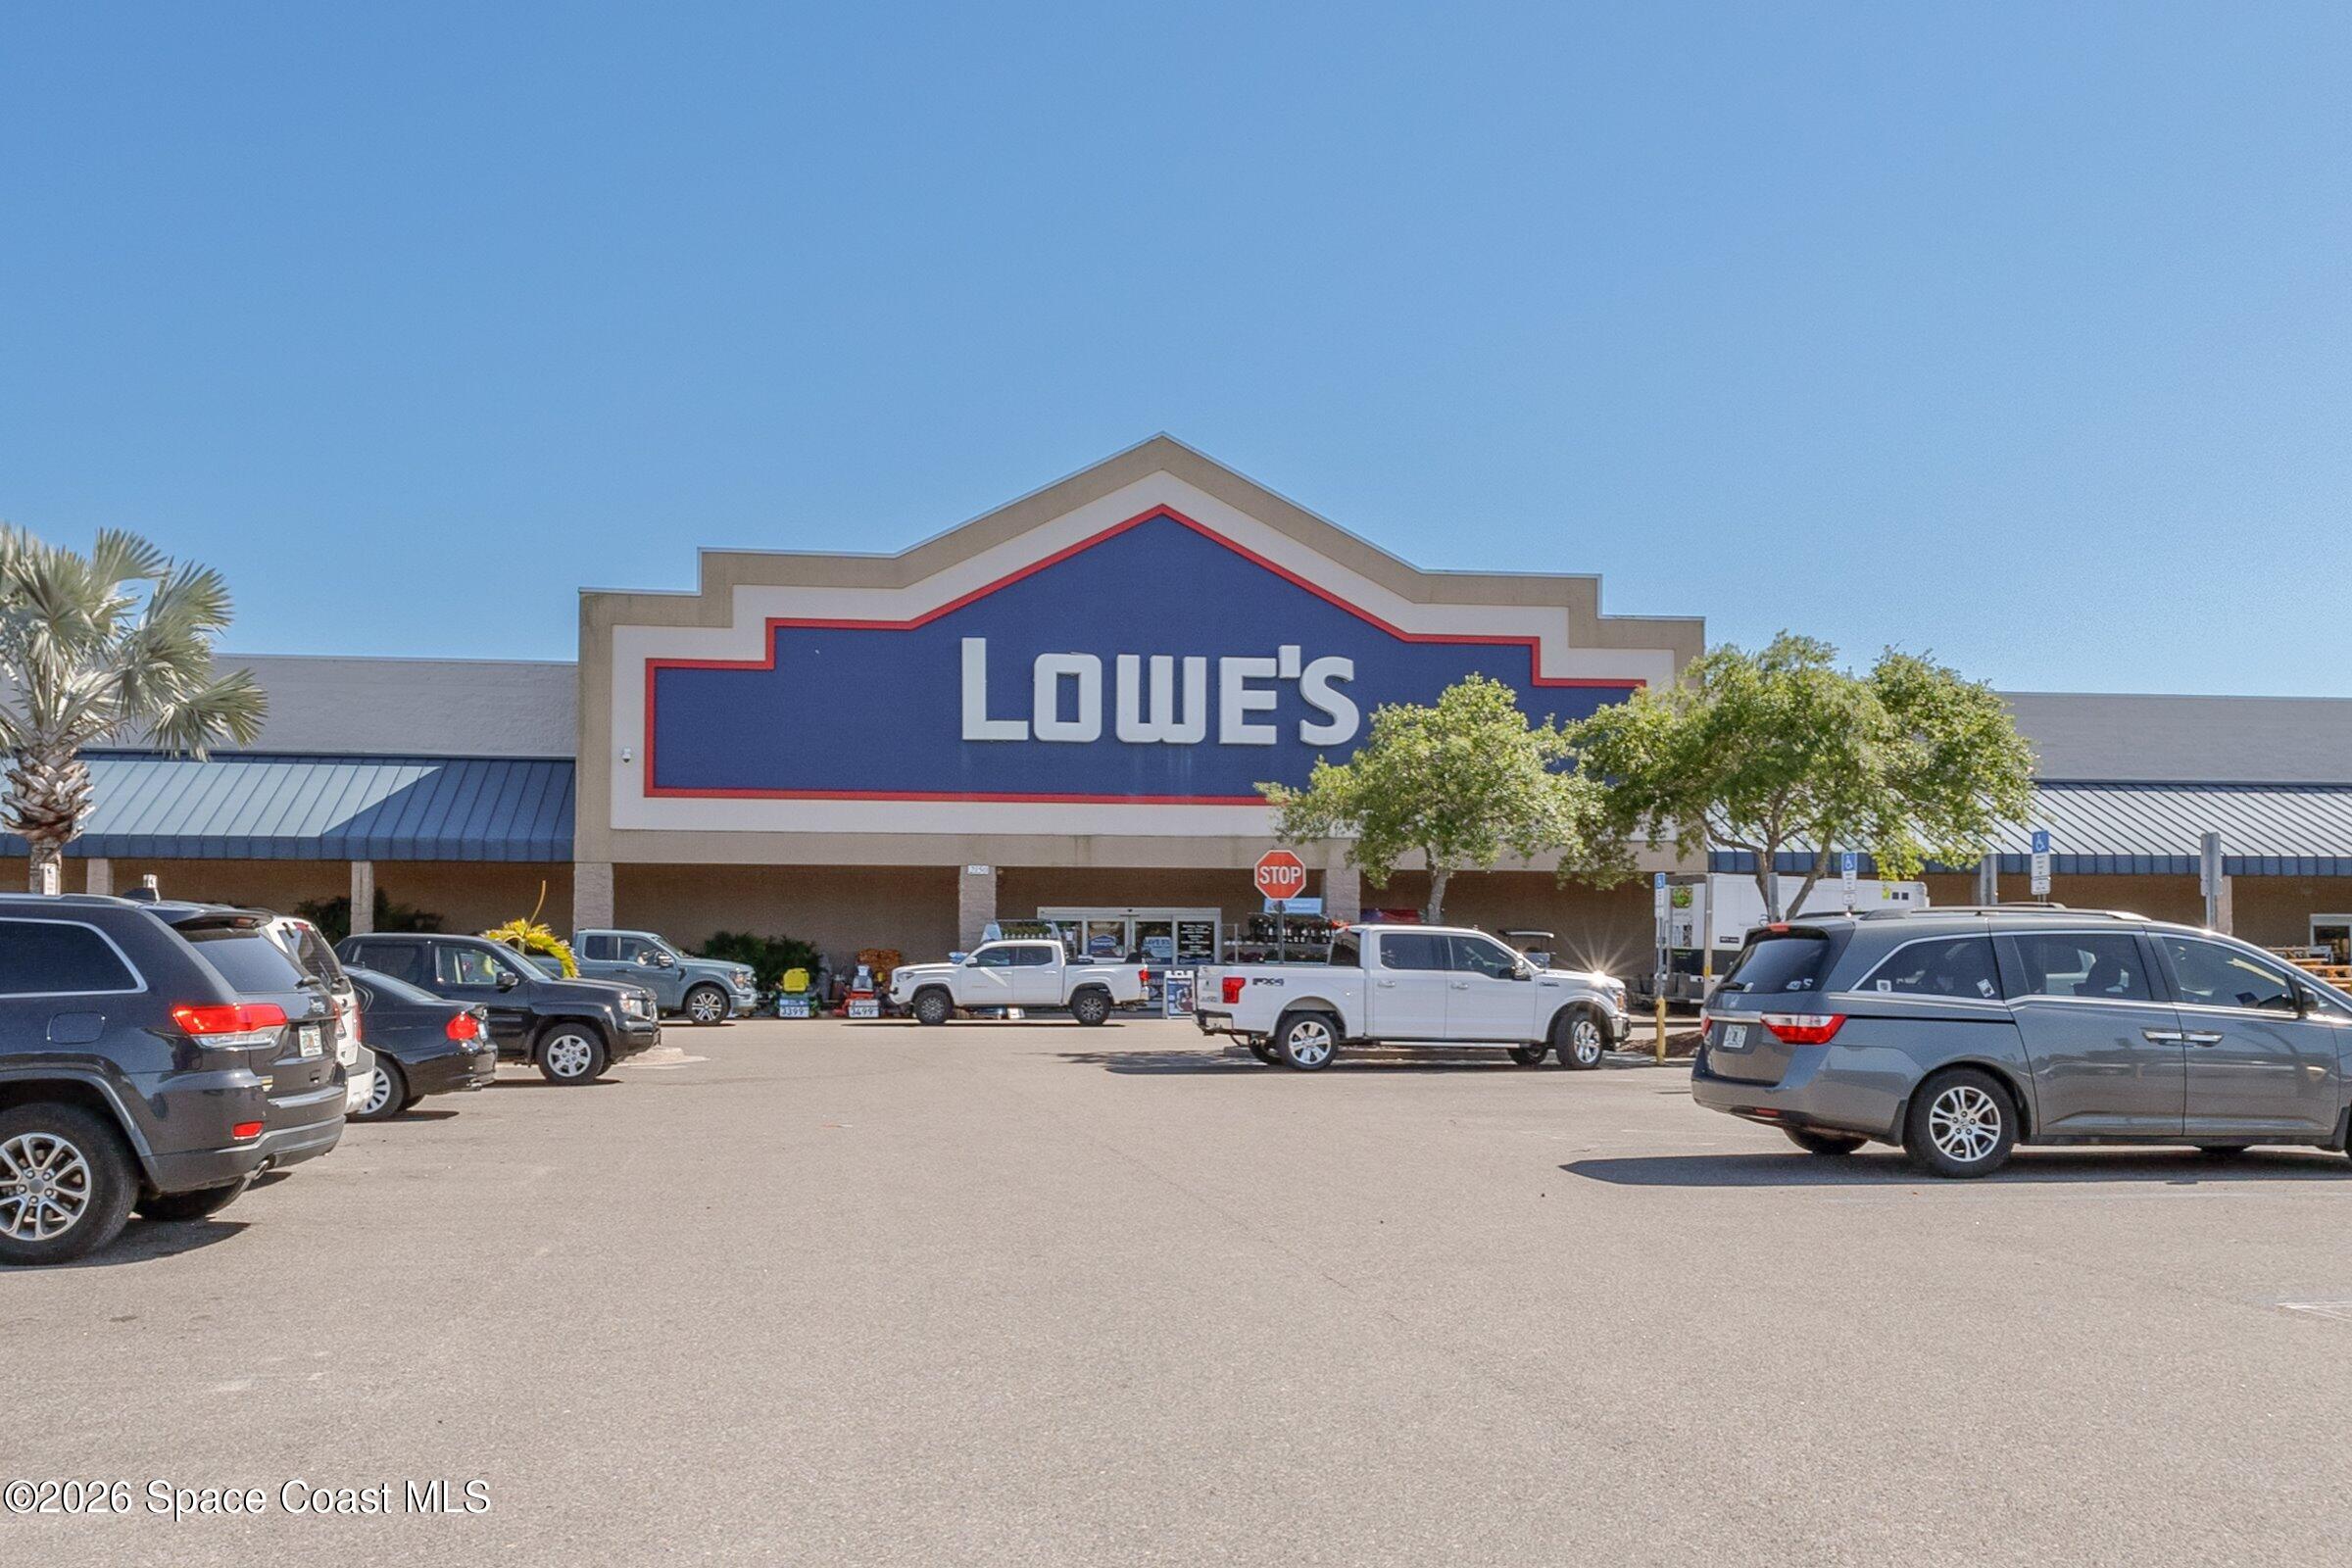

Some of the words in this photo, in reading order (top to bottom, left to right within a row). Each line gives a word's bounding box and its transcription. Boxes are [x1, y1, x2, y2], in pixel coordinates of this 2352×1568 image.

[961, 637, 1360, 746] LOWE'S
[1259, 866, 1301, 885] STOP
[1252, 978, 1284, 987] FX4
